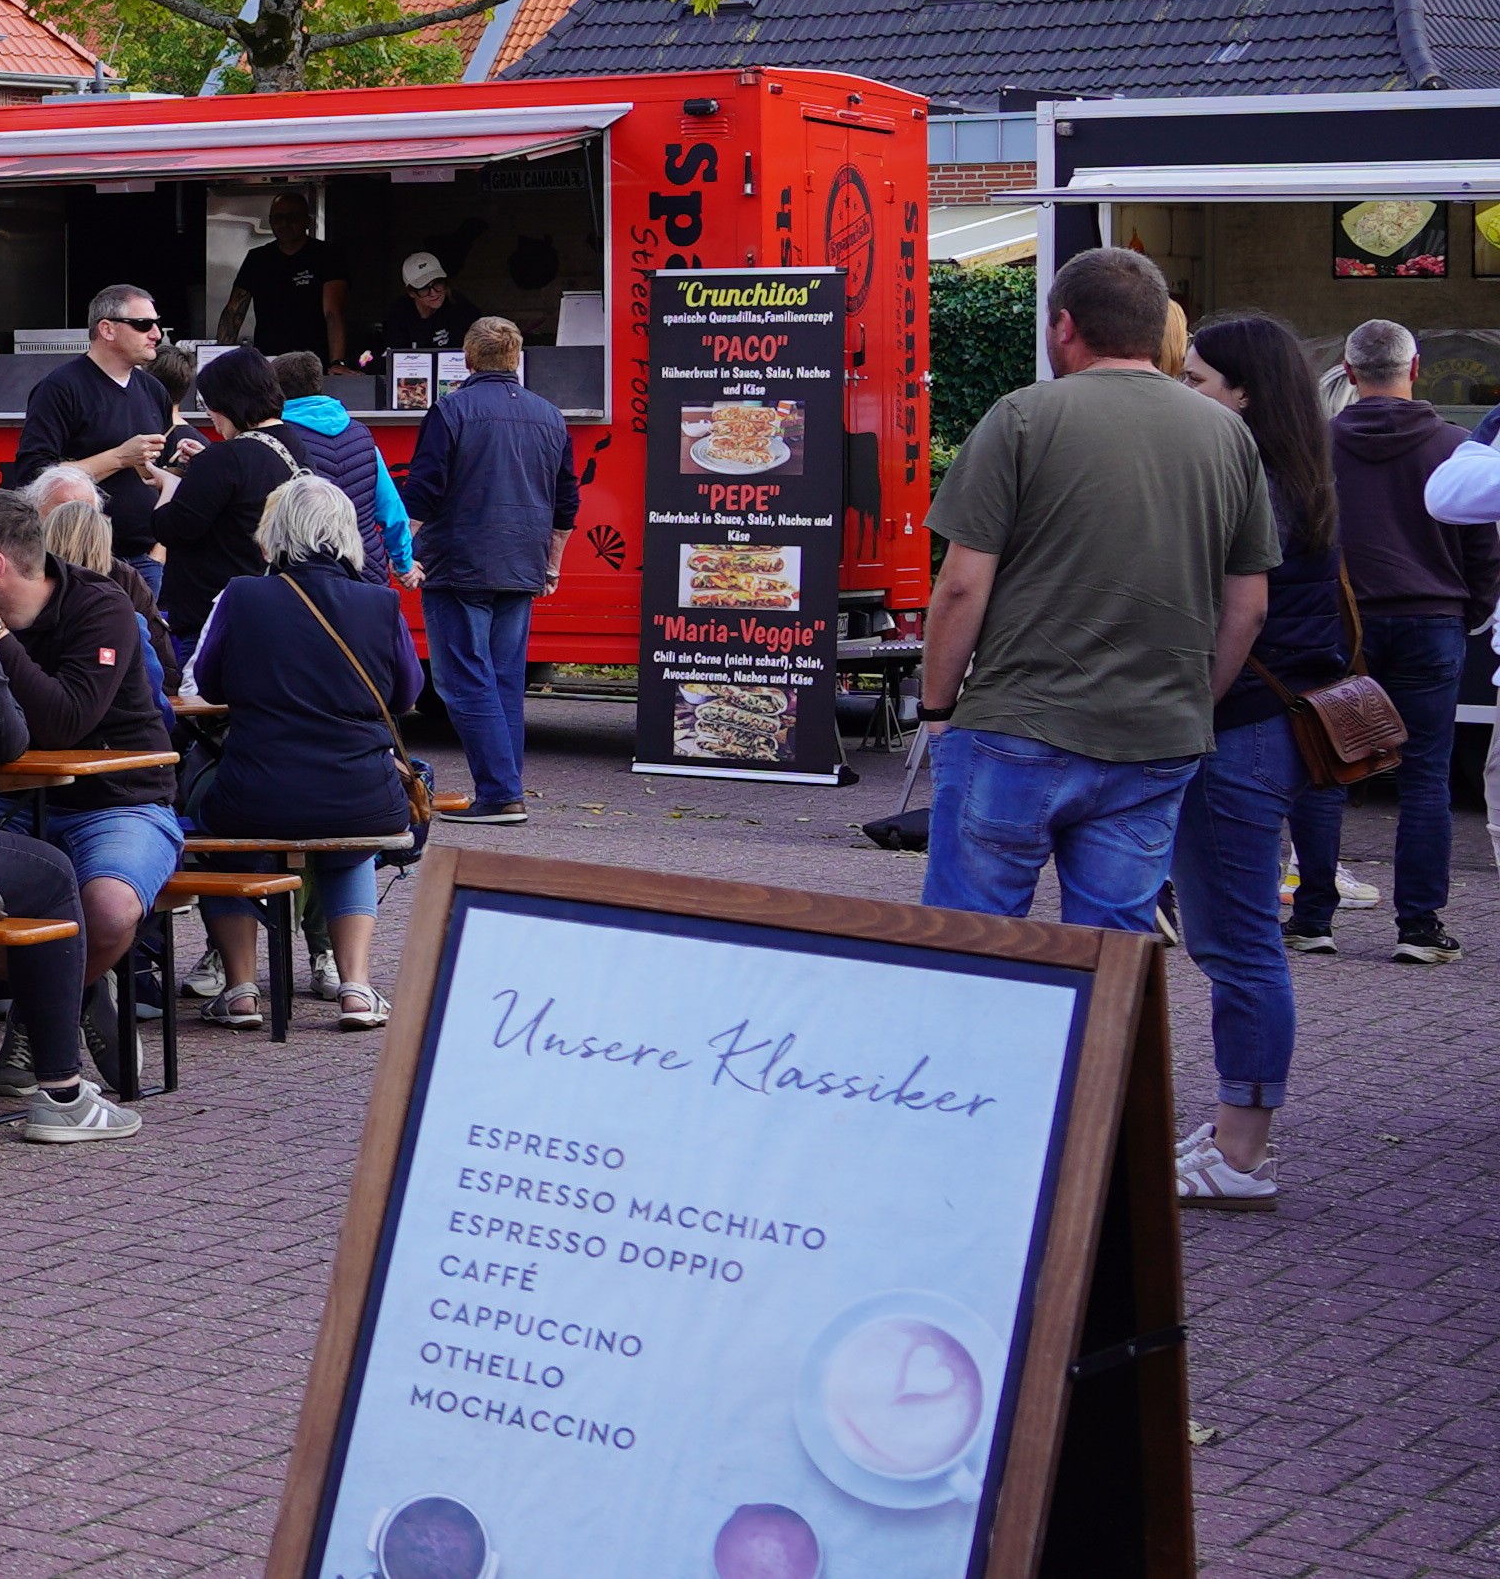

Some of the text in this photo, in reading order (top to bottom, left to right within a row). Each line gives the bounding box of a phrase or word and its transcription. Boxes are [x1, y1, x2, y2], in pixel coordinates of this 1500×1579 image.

[492, 169, 571, 190] GRAN CANARIA
[677, 279, 822, 308] "Crunchitos"
[662, 311, 707, 327] spanische
[701, 334, 789, 363] "PACO"
[900, 200, 920, 486] Spanish
[661, 366, 831, 380] Hühnerbrust in Sauce, Salat, Nachos
[722, 383, 767, 396] und Käse
[697, 483, 781, 512] "PEPE"
[649, 510, 833, 527] Rinderhack in Sauce, Salat, Nachos und
[727, 529, 751, 542] Käse
[653, 614, 826, 653] "Maria-Veggie"
[653, 650, 825, 671] Chili sin Carne (nicht scharf), Salat,
[662, 667, 814, 686] Avocadocreme, Nachos und Käse
[492, 989, 999, 1118] Unsere Klassiker
[466, 1124, 625, 1170] ESPRESSO
[457, 1167, 827, 1251] ESPRESSO MACCHIATO
[448, 1210, 744, 1283] ESPRESSO DOPPIO
[439, 1254, 540, 1292] CAFFÉ
[429, 1298, 644, 1358] CAPPUCCINO
[420, 1341, 565, 1389] OTHELLO
[410, 1384, 637, 1450] MOCHACCINO
